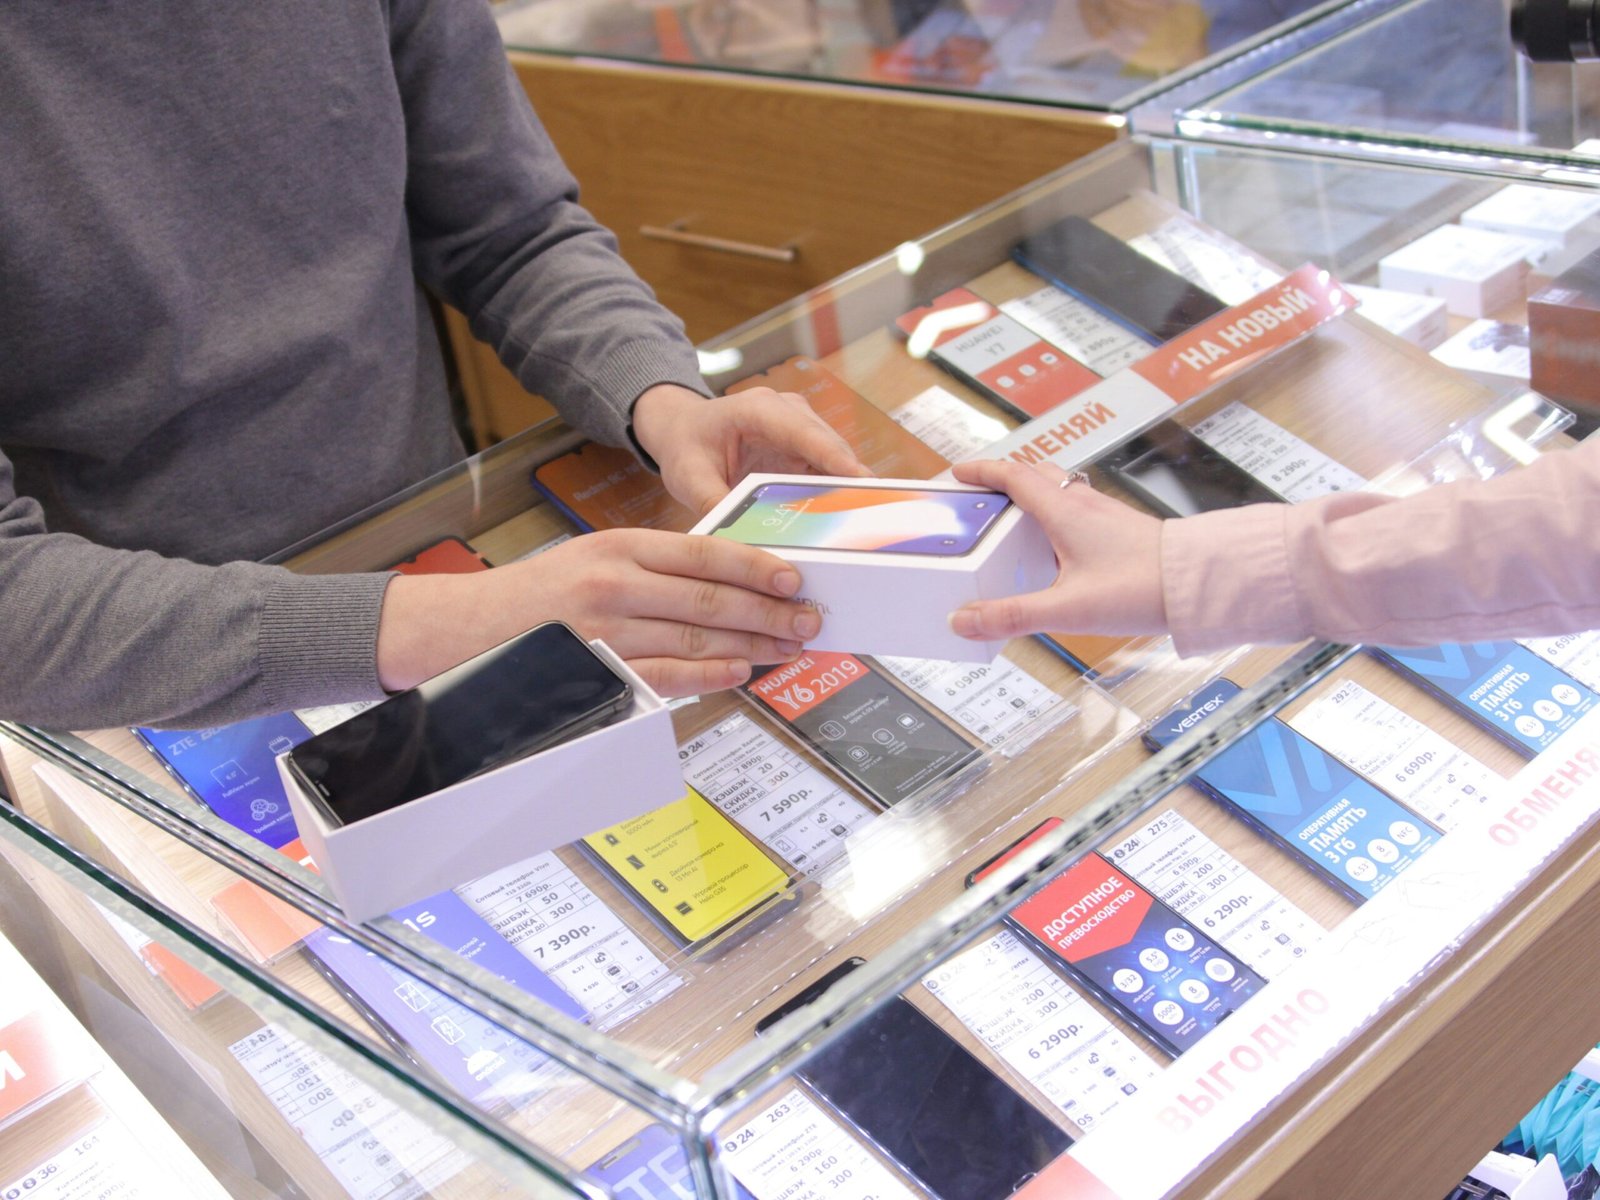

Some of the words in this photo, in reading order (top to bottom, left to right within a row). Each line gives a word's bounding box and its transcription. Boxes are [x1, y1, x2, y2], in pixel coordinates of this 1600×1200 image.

[1178, 339, 1230, 371] НА
[1218, 286, 1317, 348] НОВЫЙ
[1000, 401, 1117, 466] МЕНЯЙ
[758, 657, 815, 694] HUAWEI
[773, 683, 815, 710] Y6
[810, 659, 858, 695] 2019
[945, 687, 955, 697] 8
[955, 666, 991, 689] 090р.
[1469, 664, 1515, 701] ОПЕРАТИВНАЯ
[1332, 689, 1350, 705] 292
[1479, 671, 1530, 712] ПАМЯТЬ
[1495, 710, 1510, 722] 3
[168, 736, 197, 756] ZTE
[743, 754, 765, 769] 890р.
[758, 762, 773, 774] 20
[1395, 773, 1406, 784] 6
[1404, 750, 1436, 775] 690р.
[768, 770, 789, 786] 300
[713, 778, 750, 803] КЭШБЭК
[724, 786, 758, 811] СКИДКА
[1488, 741, 1600, 846] ОБМЕНЯ
[760, 811, 771, 822] 7
[773, 787, 813, 814] 590р.
[1298, 798, 1350, 841] ОПЕРАТИВНАЯ
[1308, 805, 1368, 852] ПАМЯТЬ
[1124, 839, 1140, 853] 24
[1147, 821, 1168, 836] 275
[1324, 850, 1339, 865] 3
[1336, 837, 1357, 857] Гб
[1179, 856, 1201, 873] 590р.
[1192, 863, 1213, 879] 200
[525, 882, 552, 899] 690р.
[1161, 881, 1189, 901] ЭШБЭК
[1207, 874, 1228, 891] 300
[541, 892, 559, 905] 50
[1043, 875, 1124, 942] ДОСТУПНОЕ
[1172, 889, 1198, 909] КИДКА
[494, 907, 530, 931] ЭШБЭК
[549, 902, 574, 920] 300
[1057, 889, 1136, 950] ПРЕВОСХОДСТВО
[1204, 917, 1216, 928] 6
[1214, 894, 1253, 921] 290р.
[503, 918, 538, 940] КИДКА
[510, 927, 534, 945] ADE-IN
[534, 947, 545, 959] 7
[548, 922, 596, 952] 390р.
[1171, 932, 1185, 944] 16
[1120, 974, 1138, 989] 3/32
[1021, 988, 1044, 1006] 200
[1035, 1000, 1059, 1018] 300
[1157, 1003, 1176, 1020] 5000
[1028, 1048, 1041, 1060] 6
[1040, 1023, 1084, 1052] 290р.
[1156, 988, 1330, 1135] ВЫГОДНО
[737, 1129, 755, 1145] 24
[767, 1104, 791, 1123] 263
[1077, 1113, 1093, 1127] OS
[38, 1163, 58, 1179] 36
[612, 1145, 699, 1200] TE
[790, 1165, 798, 1173] 6
[799, 1148, 825, 1167] 290р.
[815, 1155, 838, 1175] 160
[828, 1168, 853, 1189] 300
